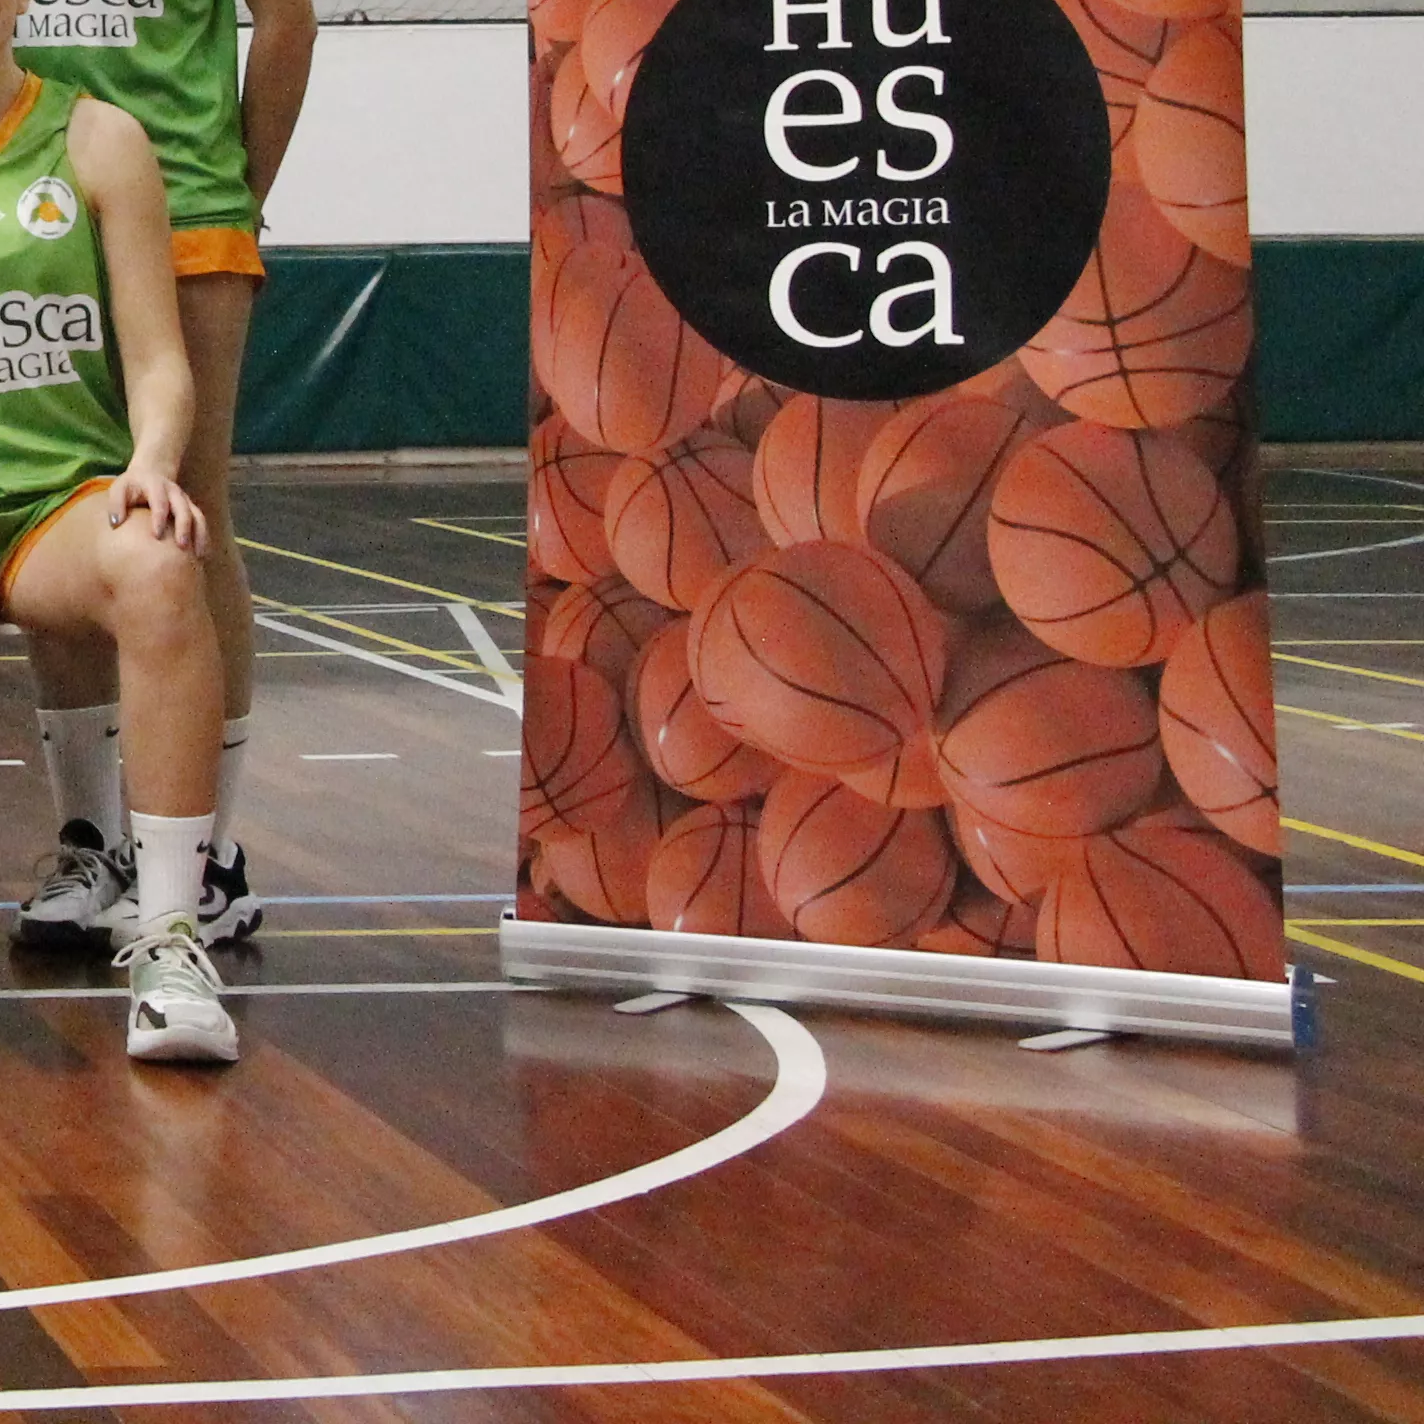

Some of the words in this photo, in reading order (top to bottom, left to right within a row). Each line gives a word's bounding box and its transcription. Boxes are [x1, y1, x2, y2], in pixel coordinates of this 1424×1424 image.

[763, 66, 953, 181] es
[766, 198, 810, 228] La
[769, 240, 964, 348] ca
